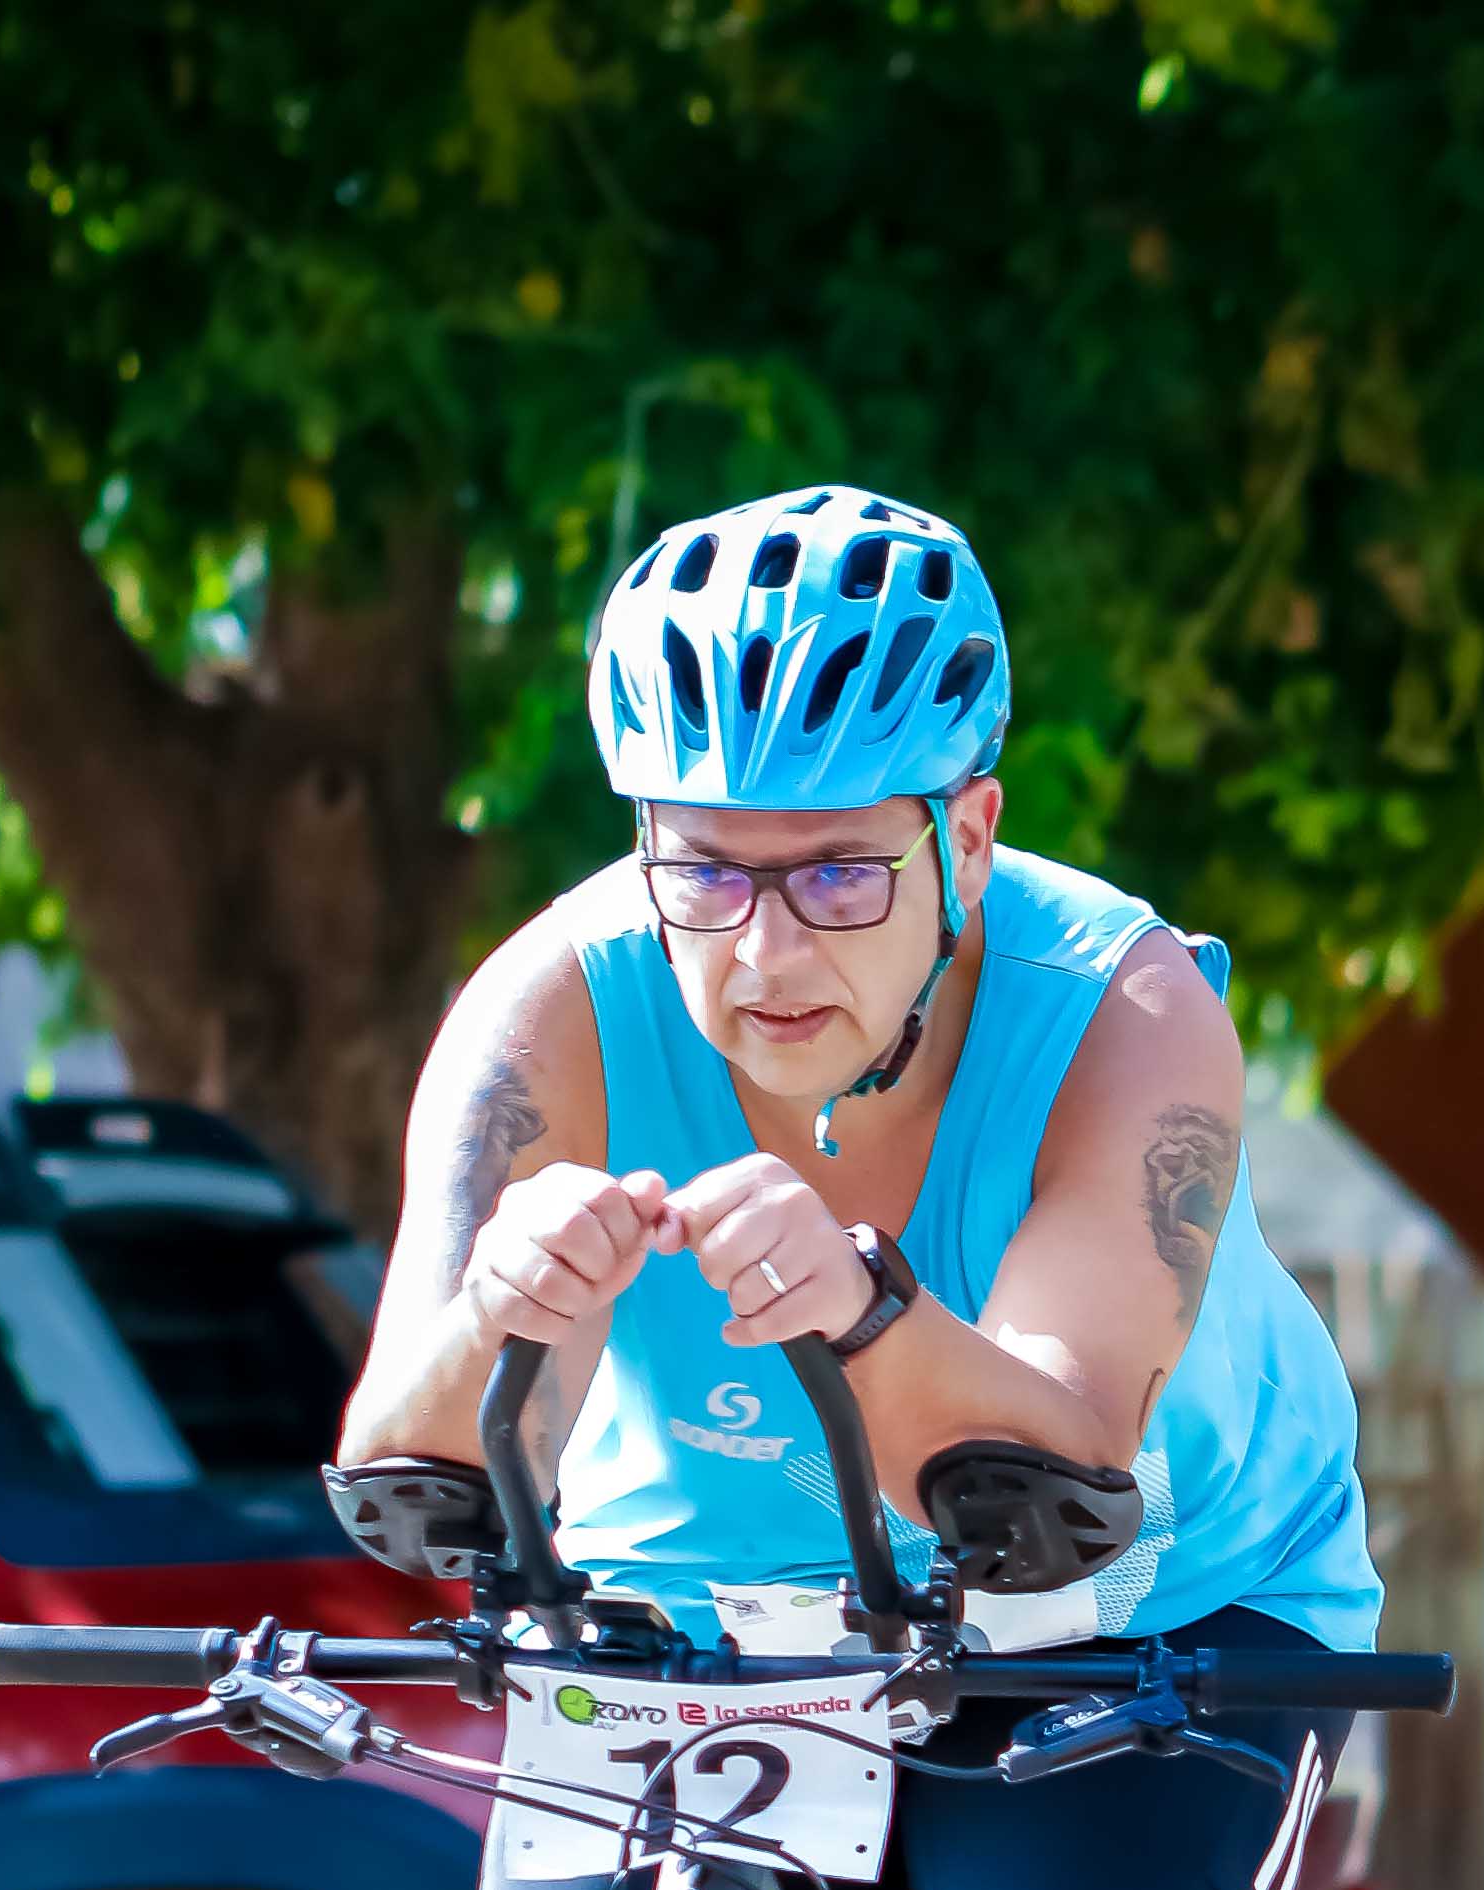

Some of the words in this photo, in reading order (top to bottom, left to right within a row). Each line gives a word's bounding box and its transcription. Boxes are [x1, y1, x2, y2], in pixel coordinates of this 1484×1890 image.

[716, 1704, 738, 1721] la
[744, 1696, 851, 1718] segunda
[607, 1739, 790, 1856] 12
